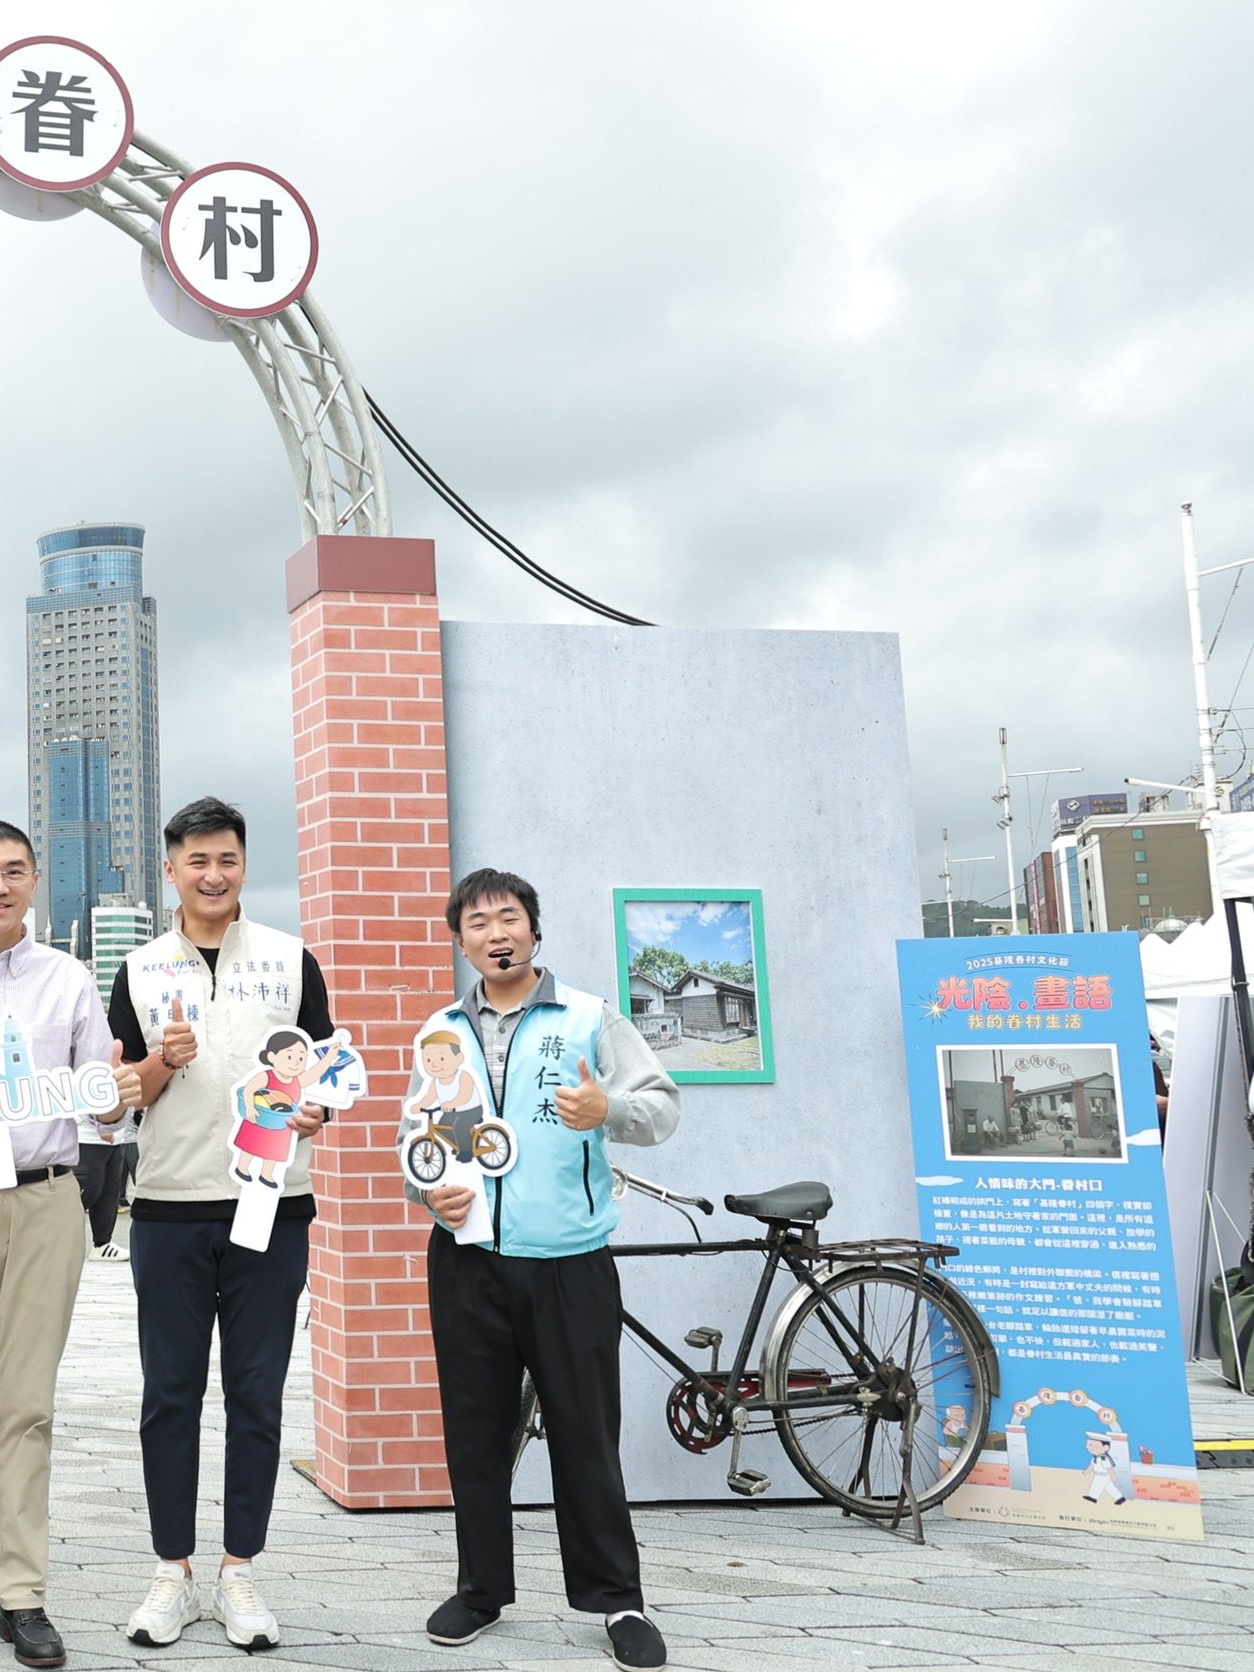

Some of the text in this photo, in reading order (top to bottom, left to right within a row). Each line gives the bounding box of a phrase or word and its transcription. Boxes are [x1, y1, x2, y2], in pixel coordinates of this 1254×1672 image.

[142, 960, 196, 973] KEELUNG
[232, 960, 284, 973] 立法委員
[227, 982, 292, 1004] 林沛祥
[967, 1013, 1084, 1030] 我的眷村生活
[531, 1034, 566, 1126] 蔣仁杰
[975, 1177, 1103, 1192] 人情味的大門-眷村口
